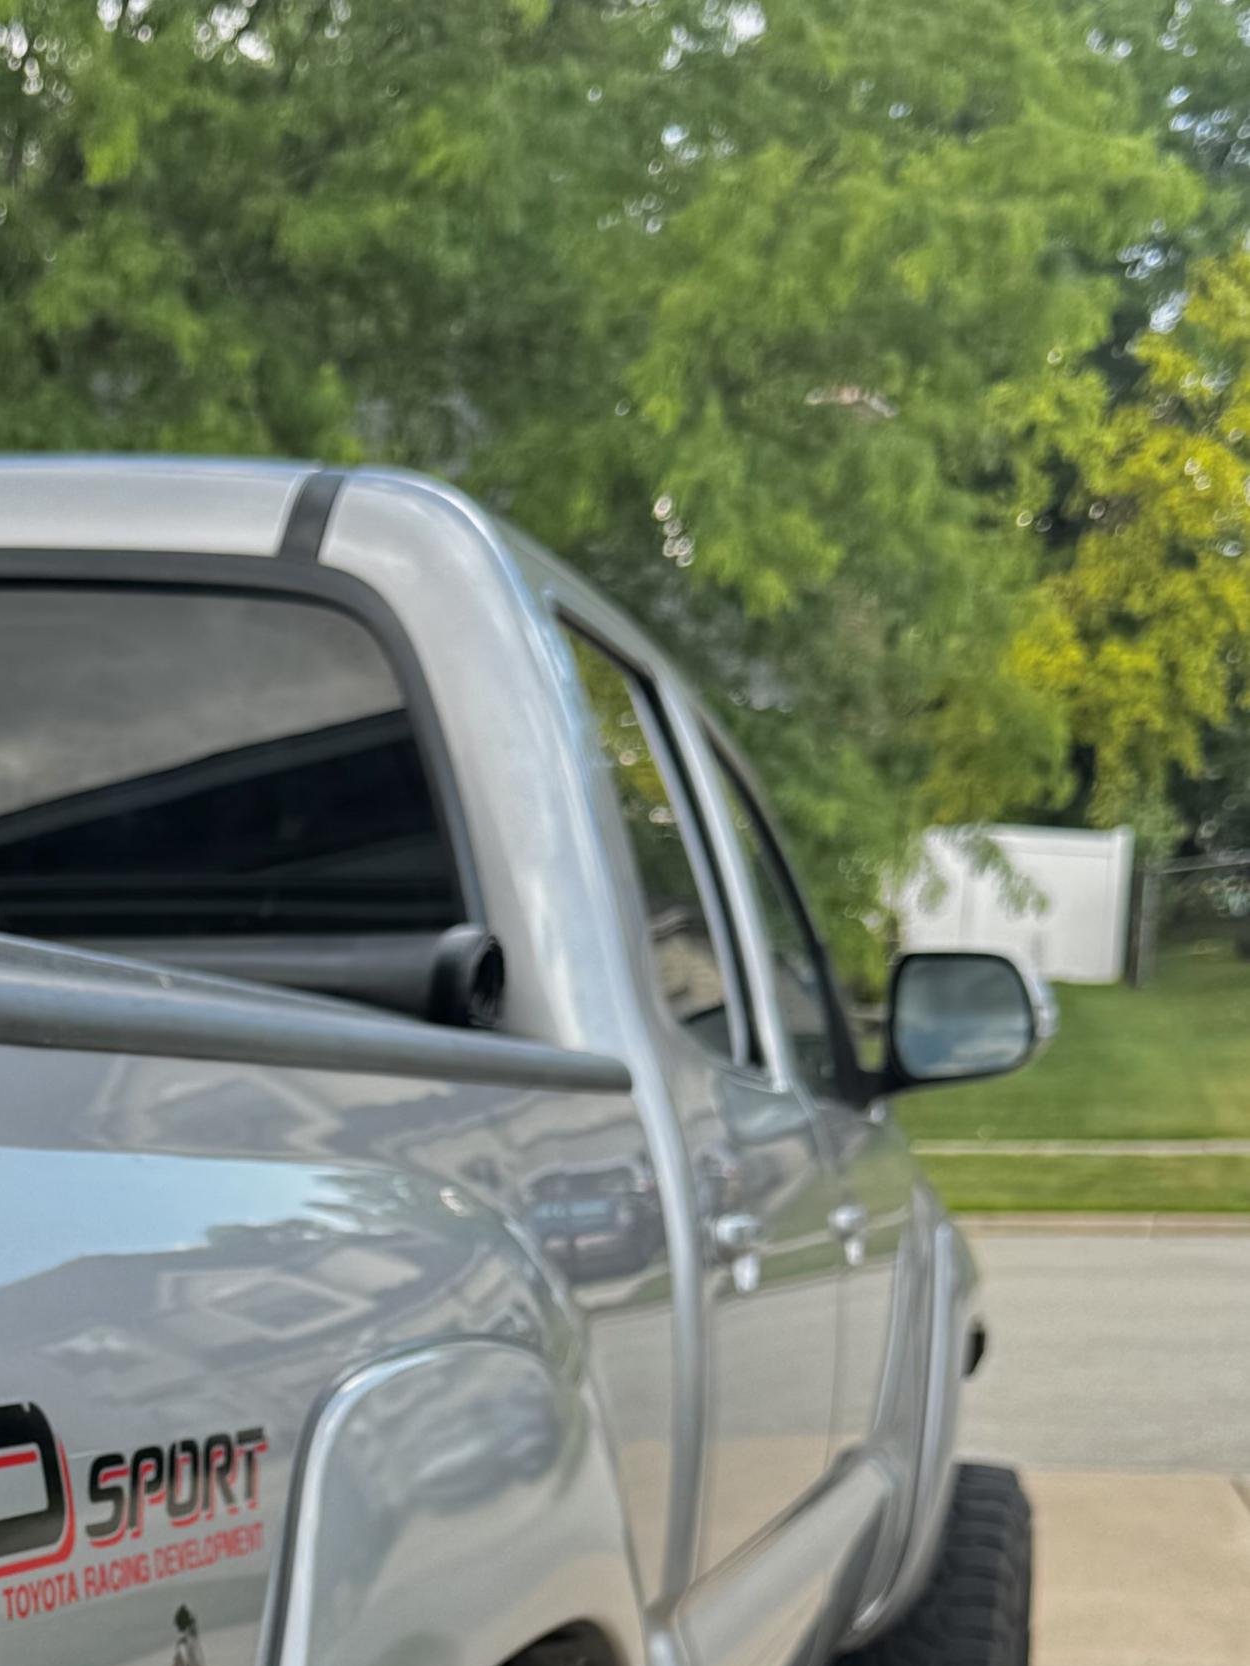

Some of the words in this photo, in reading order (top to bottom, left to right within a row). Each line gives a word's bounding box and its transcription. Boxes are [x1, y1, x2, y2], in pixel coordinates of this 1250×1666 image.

[85, 1427, 269, 1548] SPORT
[2, 1571, 80, 1621] TOYOTA
[83, 1554, 150, 1598] RACING
[153, 1522, 264, 1579] DEVELOPMENT
